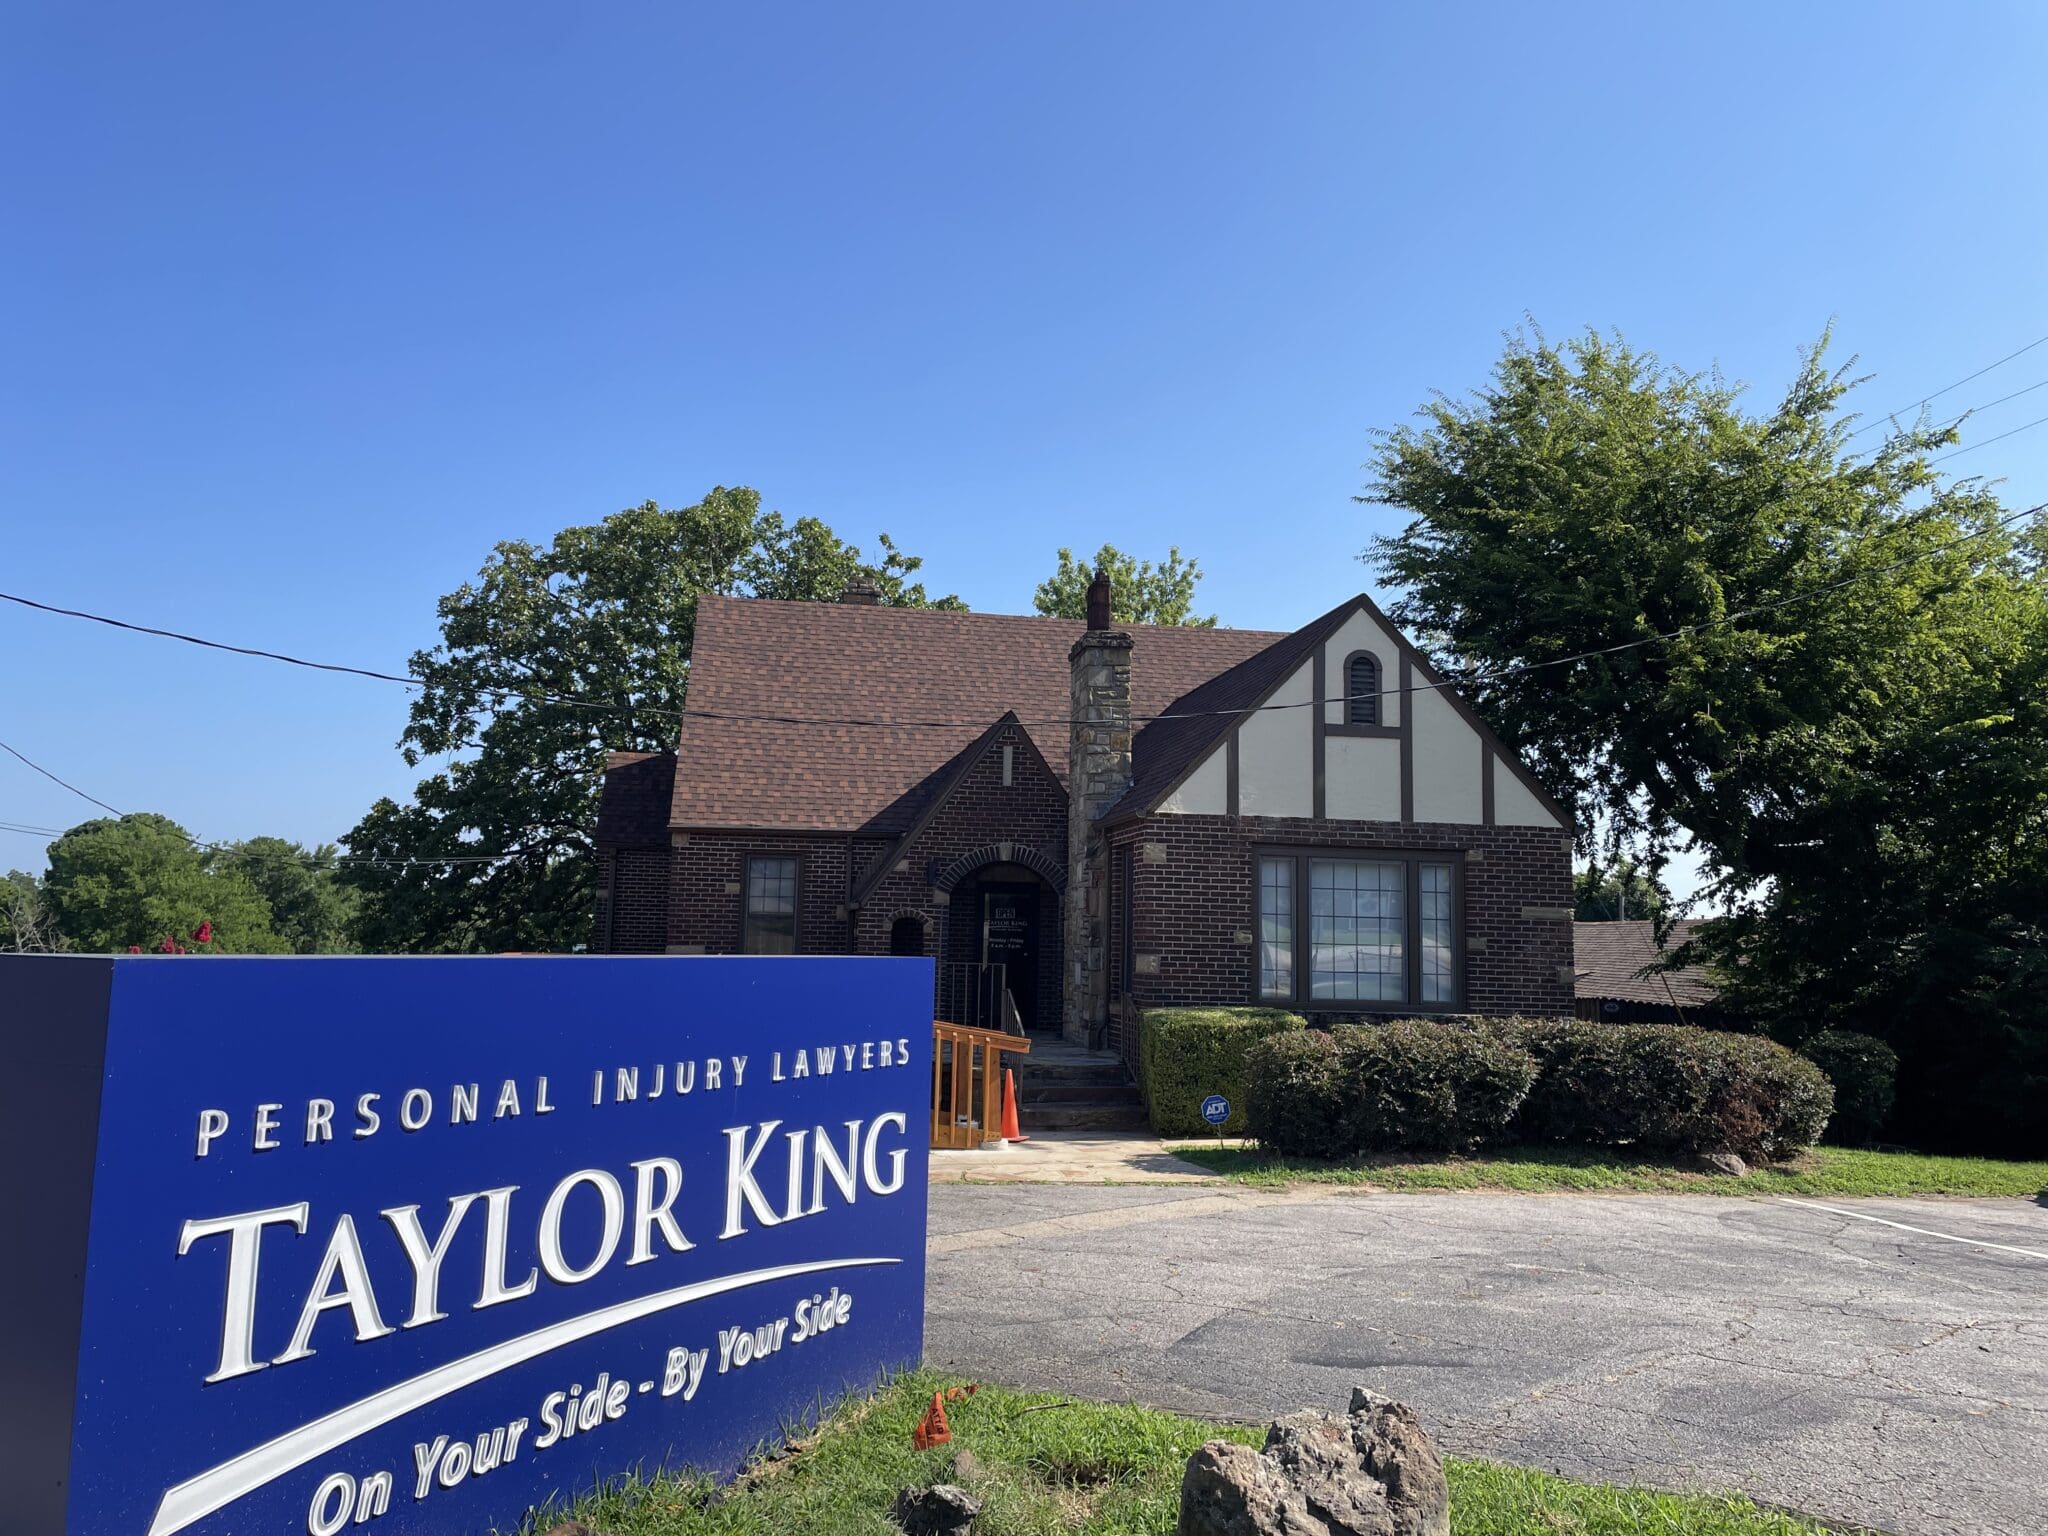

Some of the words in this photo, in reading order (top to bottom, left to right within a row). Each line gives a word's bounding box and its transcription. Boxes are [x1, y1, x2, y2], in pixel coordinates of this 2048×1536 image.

[196, 1076, 556, 1157] PERSONAL
[592, 1055, 748, 1105] INJURY
[772, 1038, 910, 1082] LAWYERS
[1206, 1102, 1226, 1115] ADT
[308, 1470, 393, 1536] On
[414, 1417, 529, 1500] Your
[535, 1374, 630, 1449] Side
[661, 1346, 709, 1402] By
[717, 1317, 788, 1374] Your
[791, 1286, 852, 1344] Side
